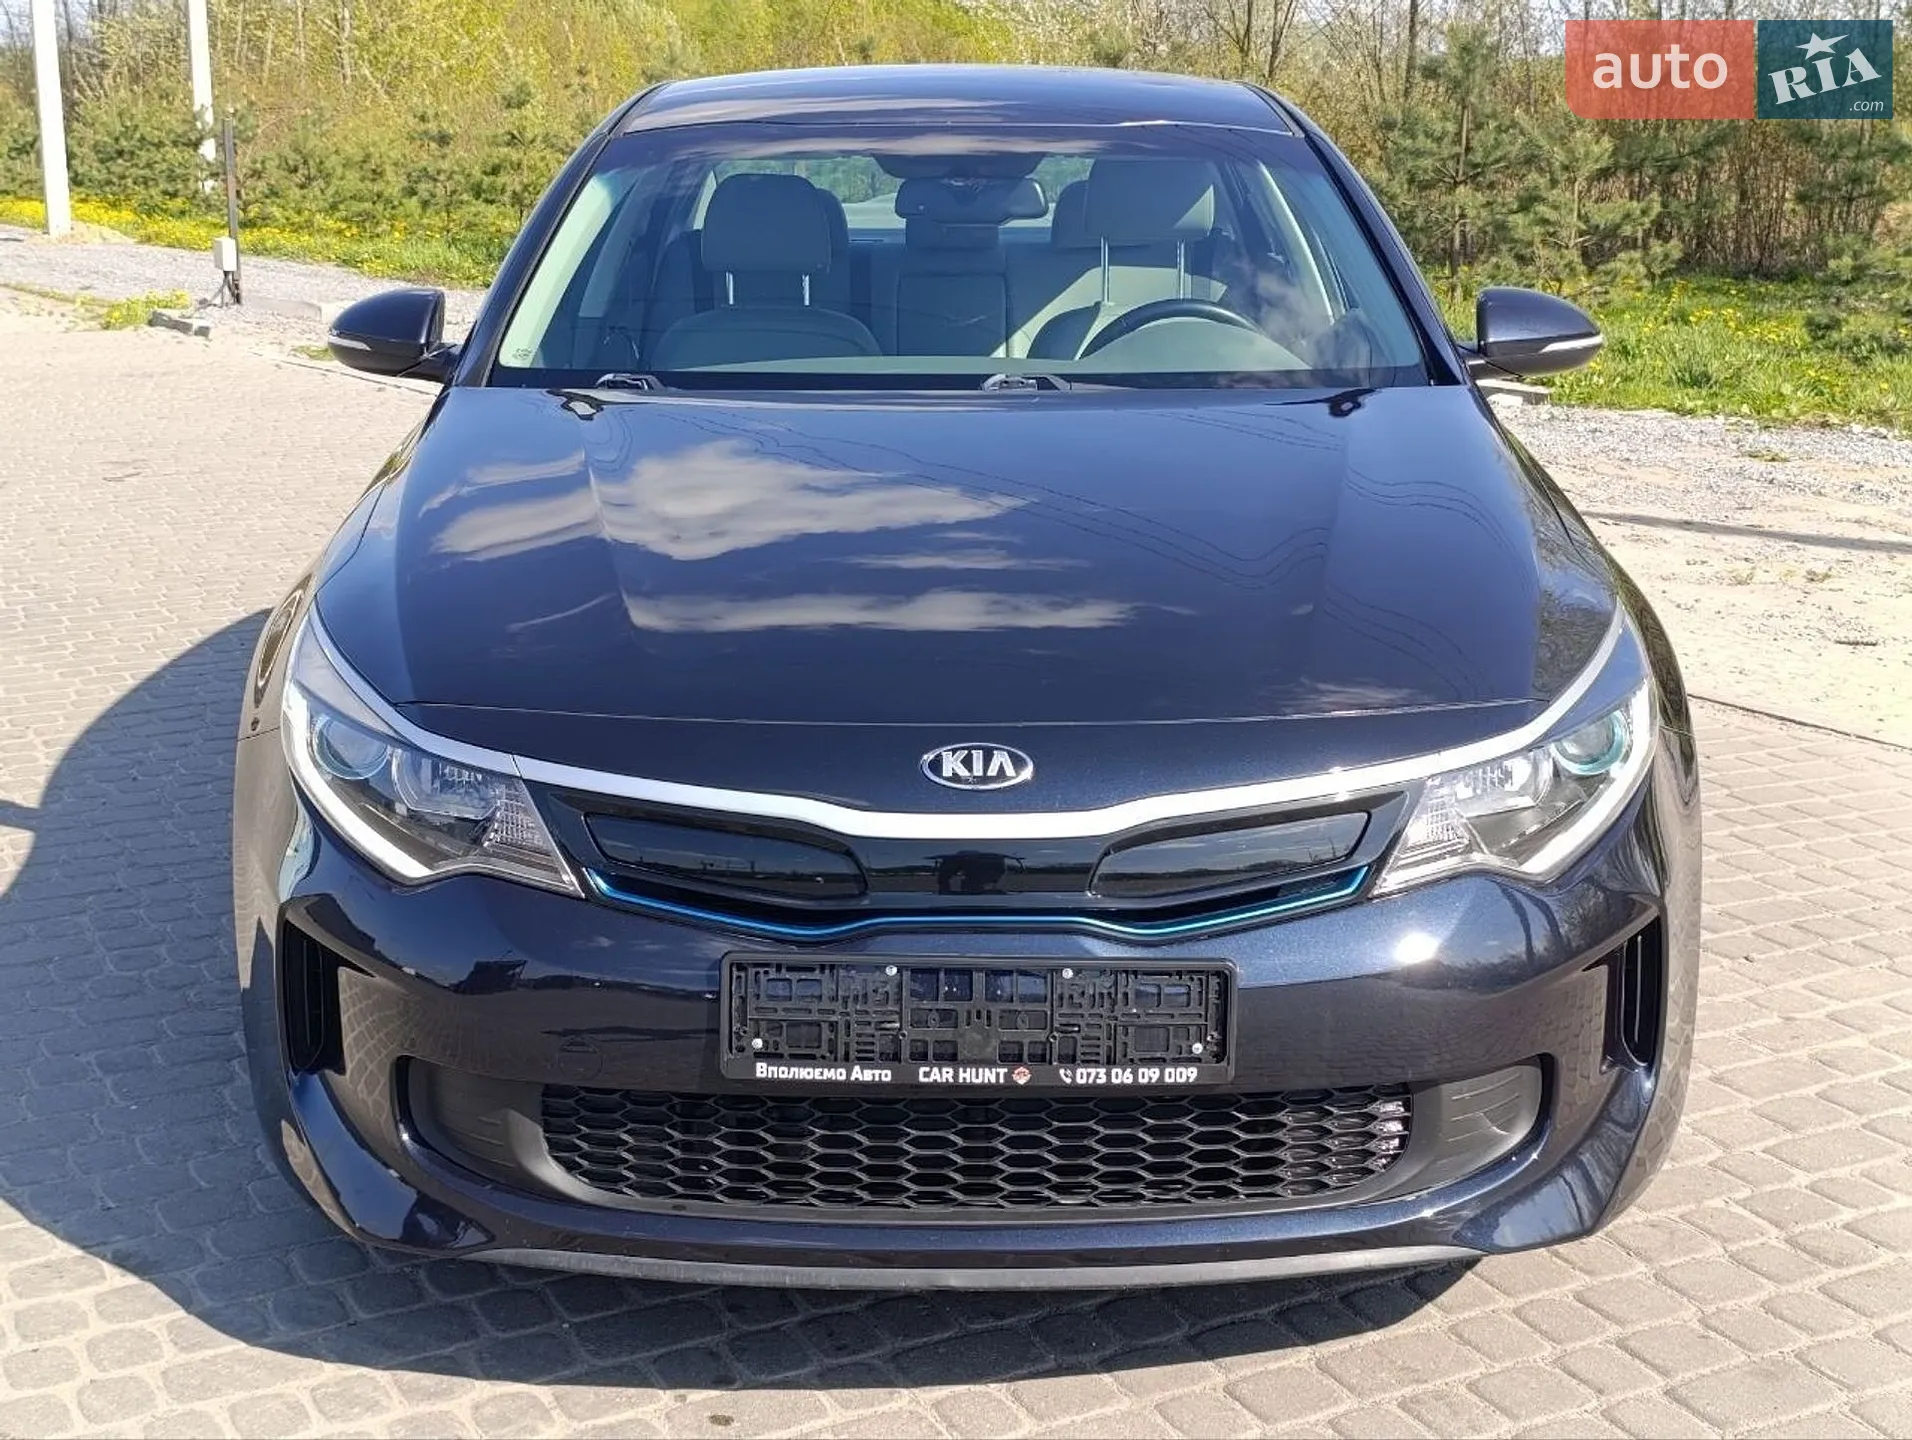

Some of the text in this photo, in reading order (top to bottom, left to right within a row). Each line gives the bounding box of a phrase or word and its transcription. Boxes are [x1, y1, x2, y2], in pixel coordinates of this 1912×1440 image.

[941, 750, 1017, 777] KIA
[850, 1065, 892, 1082] Авто
[918, 1066, 1008, 1084] CAR HUNT
[1075, 1066, 1198, 1084] 073 06 09 009
